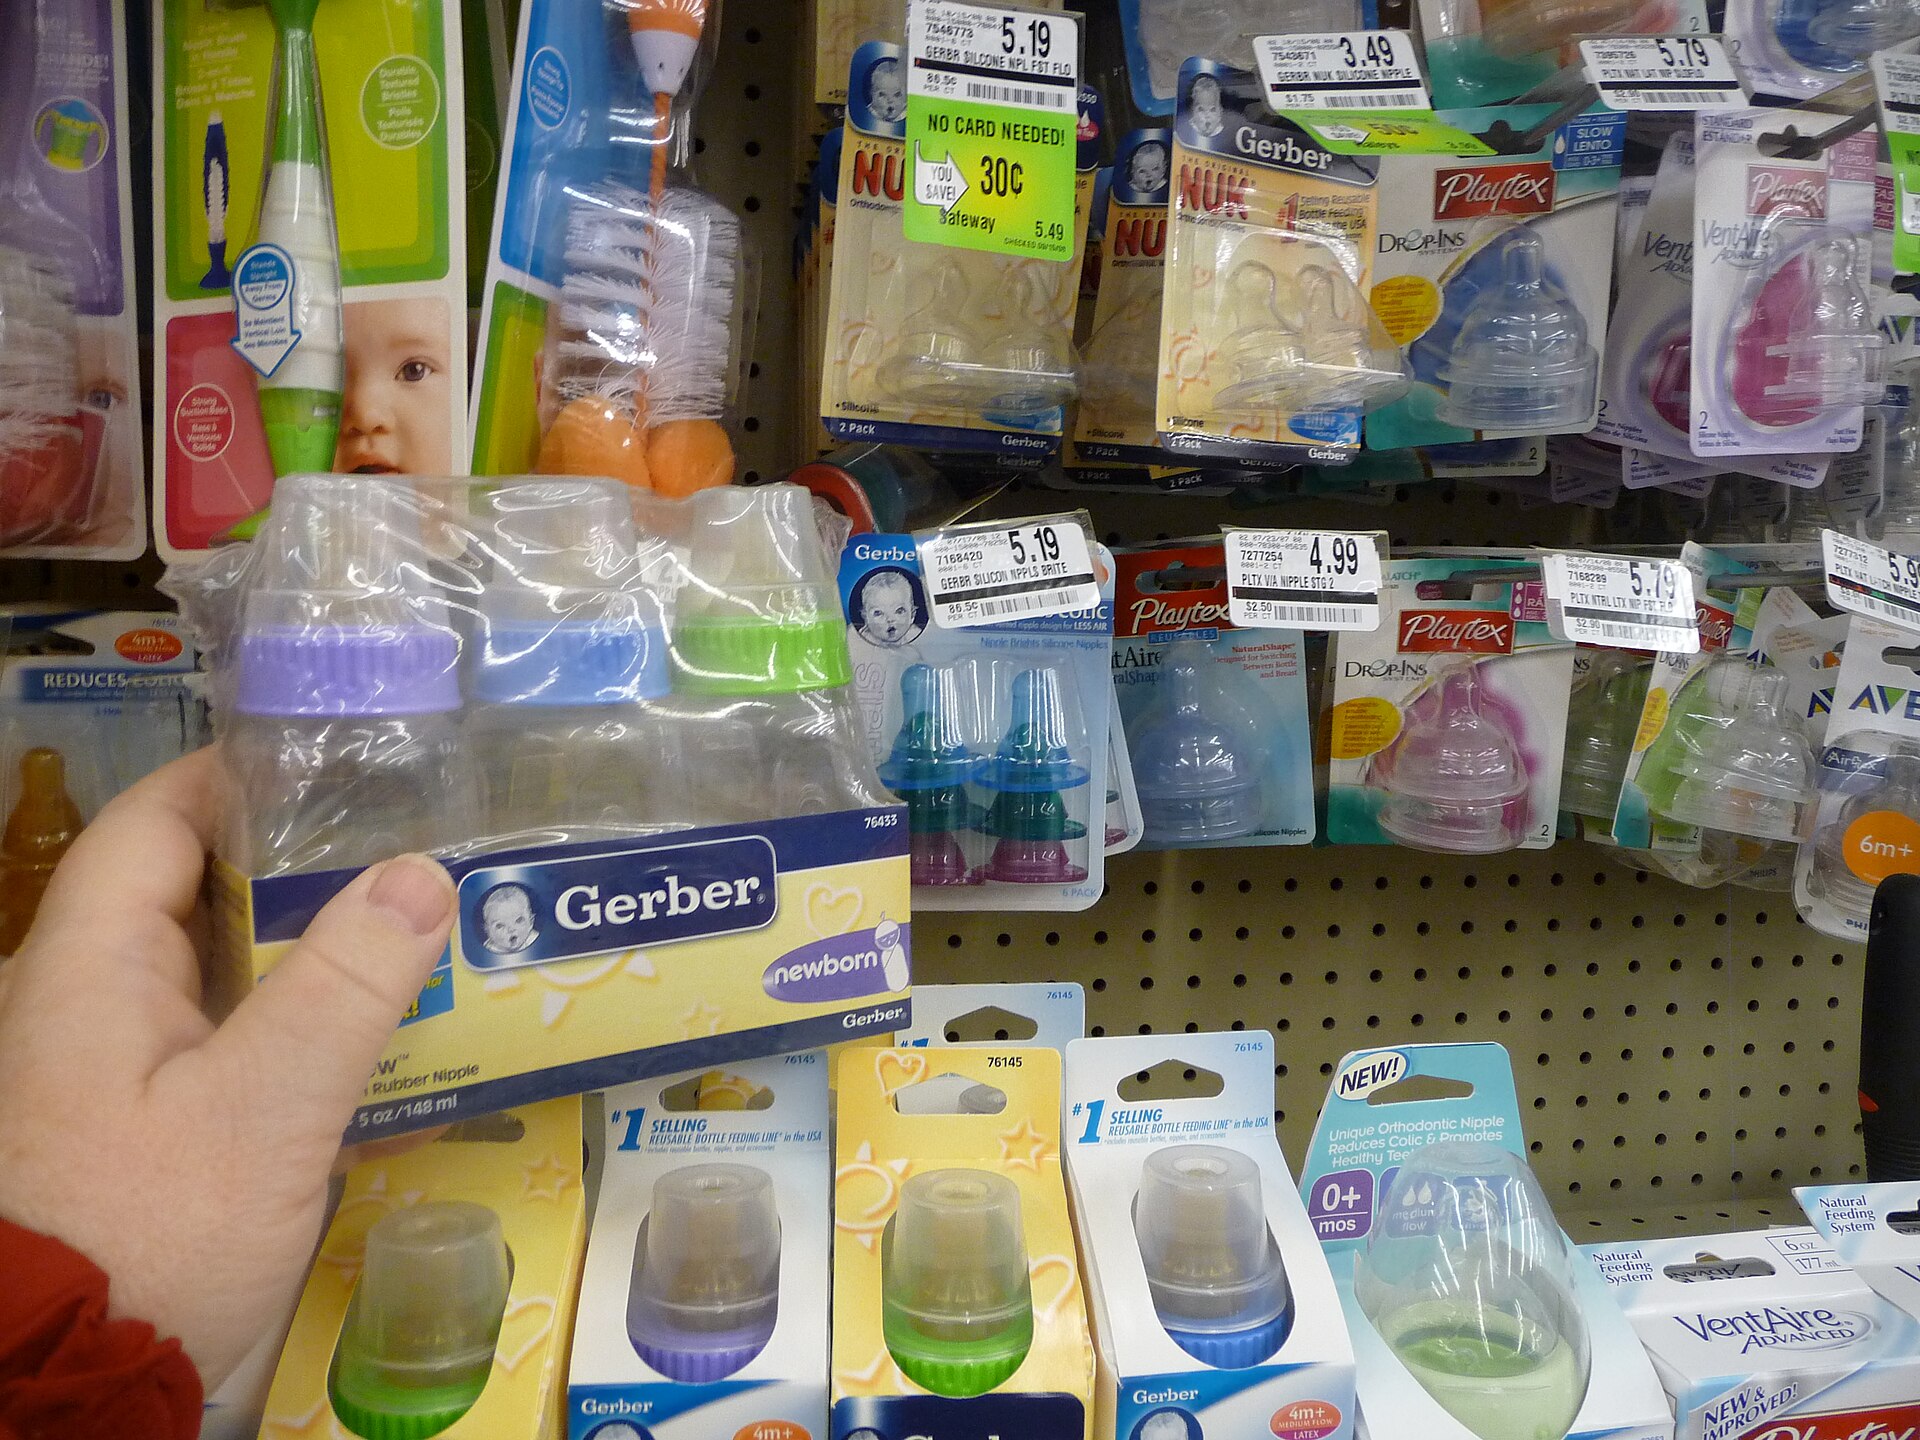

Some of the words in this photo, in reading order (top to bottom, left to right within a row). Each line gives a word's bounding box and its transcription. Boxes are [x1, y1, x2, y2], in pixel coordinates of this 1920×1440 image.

[1690, 17, 1699, 32] 2
[1002, 16, 1051, 58] 5.19
[1340, 35, 1395, 68] 3.49
[1656, 38, 1709, 67] 5.79
[928, 113, 949, 132] NO
[955, 117, 996, 137] CARD
[1001, 122, 1065, 146] NEEDED!
[1576, 126, 1613, 139] SLOW
[1235, 125, 1333, 170] Gerber
[1573, 140, 1612, 152] LENTO
[932, 166, 953, 182] YOU
[980, 155, 1023, 199] 30¢
[1181, 163, 1248, 220] NUK
[1437, 174, 1550, 214] Playtex
[1751, 172, 1825, 213] Playtex
[939, 207, 996, 234] Safeway
[1035, 220, 1065, 242] 5.49
[1598, 399, 1608, 417] 2
[1699, 410, 1709, 430] 2
[839, 423, 847, 433] 2
[849, 423, 876, 435] Pack
[1001, 434, 1048, 449] Gerber
[1170, 438, 1178, 449] 2
[1179, 438, 1202, 449] Pack
[1095, 446, 1120, 457] Pack
[1308, 447, 1347, 461] Gerber
[1529, 447, 1538, 461] 2
[1178, 474, 1203, 487] Pack
[855, 544, 916, 562] Gerbe
[1008, 527, 1060, 565] 5.19
[1240, 550, 1283, 562] 7277254
[1309, 537, 1358, 575] 4.99
[940, 574, 972, 590] GERBR
[974, 569, 1009, 586] SILICON
[1010, 565, 1039, 581] NPPLS
[1041, 562, 1068, 577] BRITE
[1242, 574, 1262, 587] PLTX
[1281, 576, 1309, 589] NIPPLE
[1311, 577, 1327, 590] STG
[1329, 577, 1336, 590] 2
[1629, 561, 1675, 599] 5.79
[1246, 602, 1273, 613] $2.50
[1570, 592, 1590, 605] PLTX
[1592, 594, 1612, 607] NTRL
[1613, 596, 1627, 609] LTX
[1130, 598, 1230, 634] Playtex
[1576, 618, 1601, 629] $2.90
[1074, 622, 1092, 631] LESS
[1093, 622, 1108, 631] AIR
[1402, 614, 1507, 648] Playtex
[1076, 639, 1109, 651] Nipples
[1243, 661, 1273, 671] Between
[1276, 660, 1298, 669] Bottle
[1345, 659, 1427, 678] DROP-INS
[43, 672, 126, 689] REDUCES
[1260, 671, 1273, 680] and
[1275, 669, 1297, 679] Breast
[864, 814, 898, 829] 76433
[1541, 824, 1549, 837] 2
[1860, 835, 1913, 859] 6m+
[1062, 888, 1068, 897] 6
[1069, 888, 1097, 898] PACK
[555, 875, 761, 931] Gerber
[773, 948, 878, 986] newborn
[1047, 991, 1073, 1000] 76145
[842, 1006, 904, 1029] Gerber
[1235, 1042, 1263, 1052] 76145
[784, 1055, 816, 1065] 76145
[987, 1056, 1023, 1068] 76145
[373, 1074, 429, 1095] Rubber
[433, 1063, 480, 1084] Nipple
[1340, 1056, 1399, 1095] NEW!
[359, 1113, 371, 1128] 5
[435, 1093, 458, 1111] ml
[1111, 1108, 1163, 1125] SELLING
[611, 1107, 647, 1151] #1
[652, 1118, 708, 1133] SELLING
[1072, 1100, 1105, 1144] #1
[1109, 1124, 1149, 1136] REUSABLE
[1152, 1122, 1180, 1134] BOTTLE
[1183, 1121, 1211, 1132] FEEDING
[1234, 1119, 1241, 1129] in
[1243, 1118, 1253, 1129] the
[1255, 1117, 1269, 1128] USA
[1329, 1125, 1375, 1142] Unique
[1378, 1117, 1457, 1134] Orthodontic
[1460, 1115, 1505, 1130] Nipple
[650, 1133, 692, 1145] REUSABLE
[695, 1132, 727, 1144] BOTTLE
[728, 1132, 760, 1143] FEEDING
[784, 1132, 792, 1142] in
[793, 1131, 805, 1142] the
[807, 1130, 822, 1142] USA
[1329, 1138, 1385, 1155] Reduces
[1389, 1134, 1422, 1147] Colic
[1427, 1134, 1435, 1144] &
[1439, 1130, 1503, 1143] Promotes
[1332, 1152, 1383, 1168] Healthy
[1323, 1183, 1361, 1211] 0+
[1819, 1195, 1867, 1208] Natural
[1393, 1208, 1436, 1220] medium
[1825, 1207, 1876, 1221] Feeding
[1319, 1217, 1356, 1234] mos
[1402, 1220, 1428, 1231] flow
[1830, 1222, 1876, 1236] System
[1785, 1238, 1798, 1252] 6
[1799, 1241, 1818, 1251] oz
[1593, 1250, 1643, 1262] Natural
[1796, 1256, 1822, 1270] 177
[1599, 1259, 1653, 1274] Feeding
[1606, 1271, 1653, 1286] System
[1674, 1305, 1841, 1342] VentAire
[1740, 1328, 1855, 1354] ADVANCED
[1133, 1387, 1199, 1405] Gerber
[581, 1398, 653, 1415] Gerber
[1289, 1406, 1325, 1420] 4m+
[1704, 1386, 1752, 1430] NEW
[1755, 1385, 1765, 1399] &
[1278, 1419, 1311, 1429] MEDIUM
[1312, 1417, 1334, 1427] FLOW
[754, 1425, 793, 1440] 4m+
[1294, 1429, 1319, 1440] LATEX
